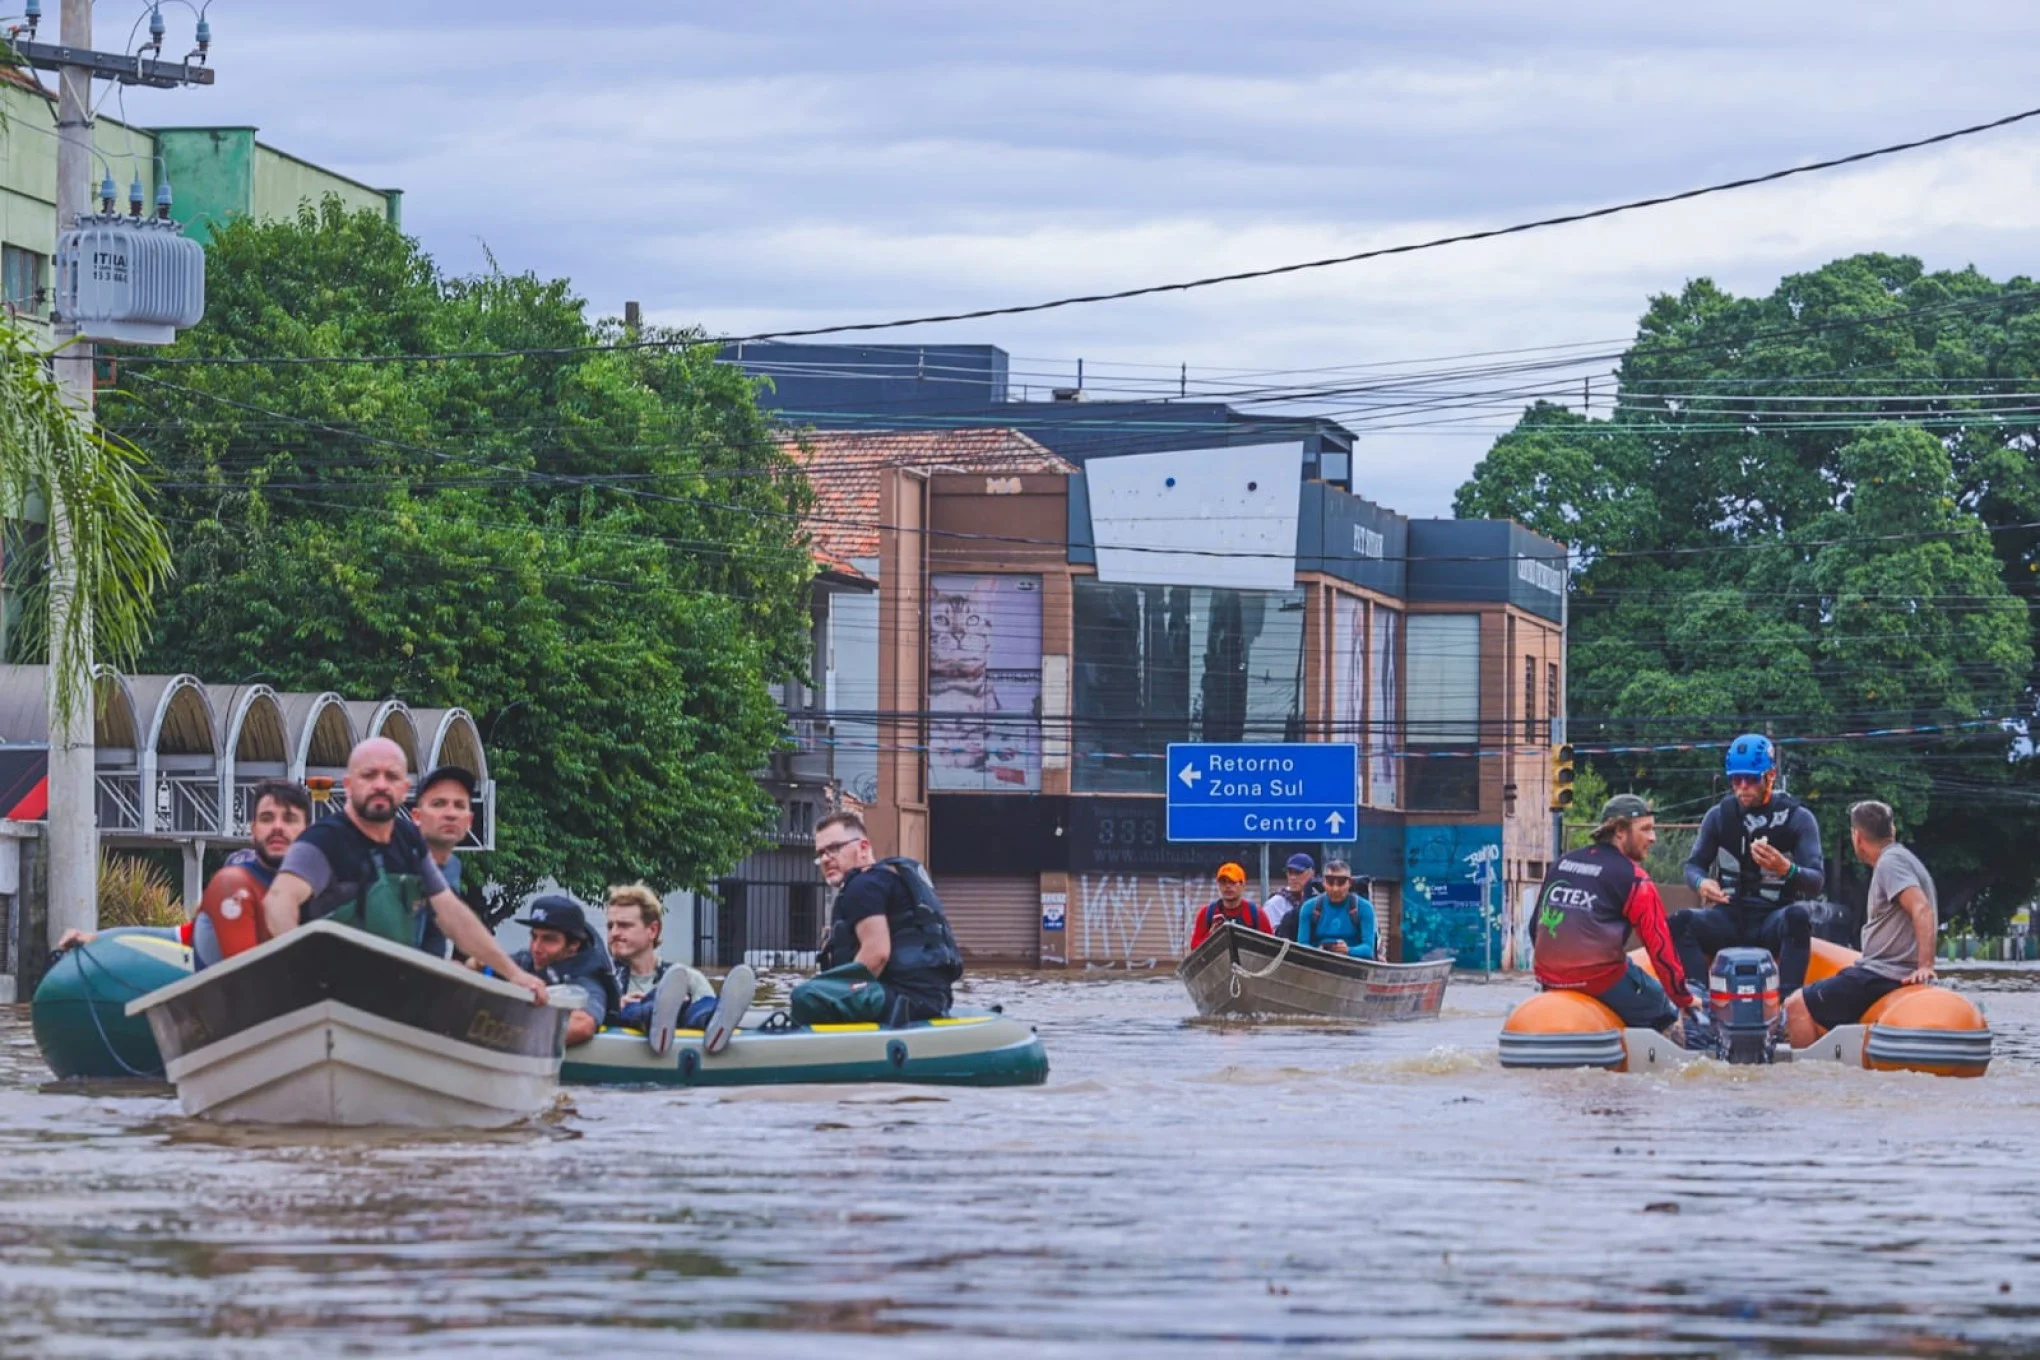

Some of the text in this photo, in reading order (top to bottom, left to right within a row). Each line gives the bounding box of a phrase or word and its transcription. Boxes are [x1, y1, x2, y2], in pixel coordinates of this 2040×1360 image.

[1209, 755, 1294, 772] Retorno
[1209, 779, 1303, 796] Zona Sul
[1243, 814, 1317, 831] Centro
[1549, 886, 1598, 909] CTEX
